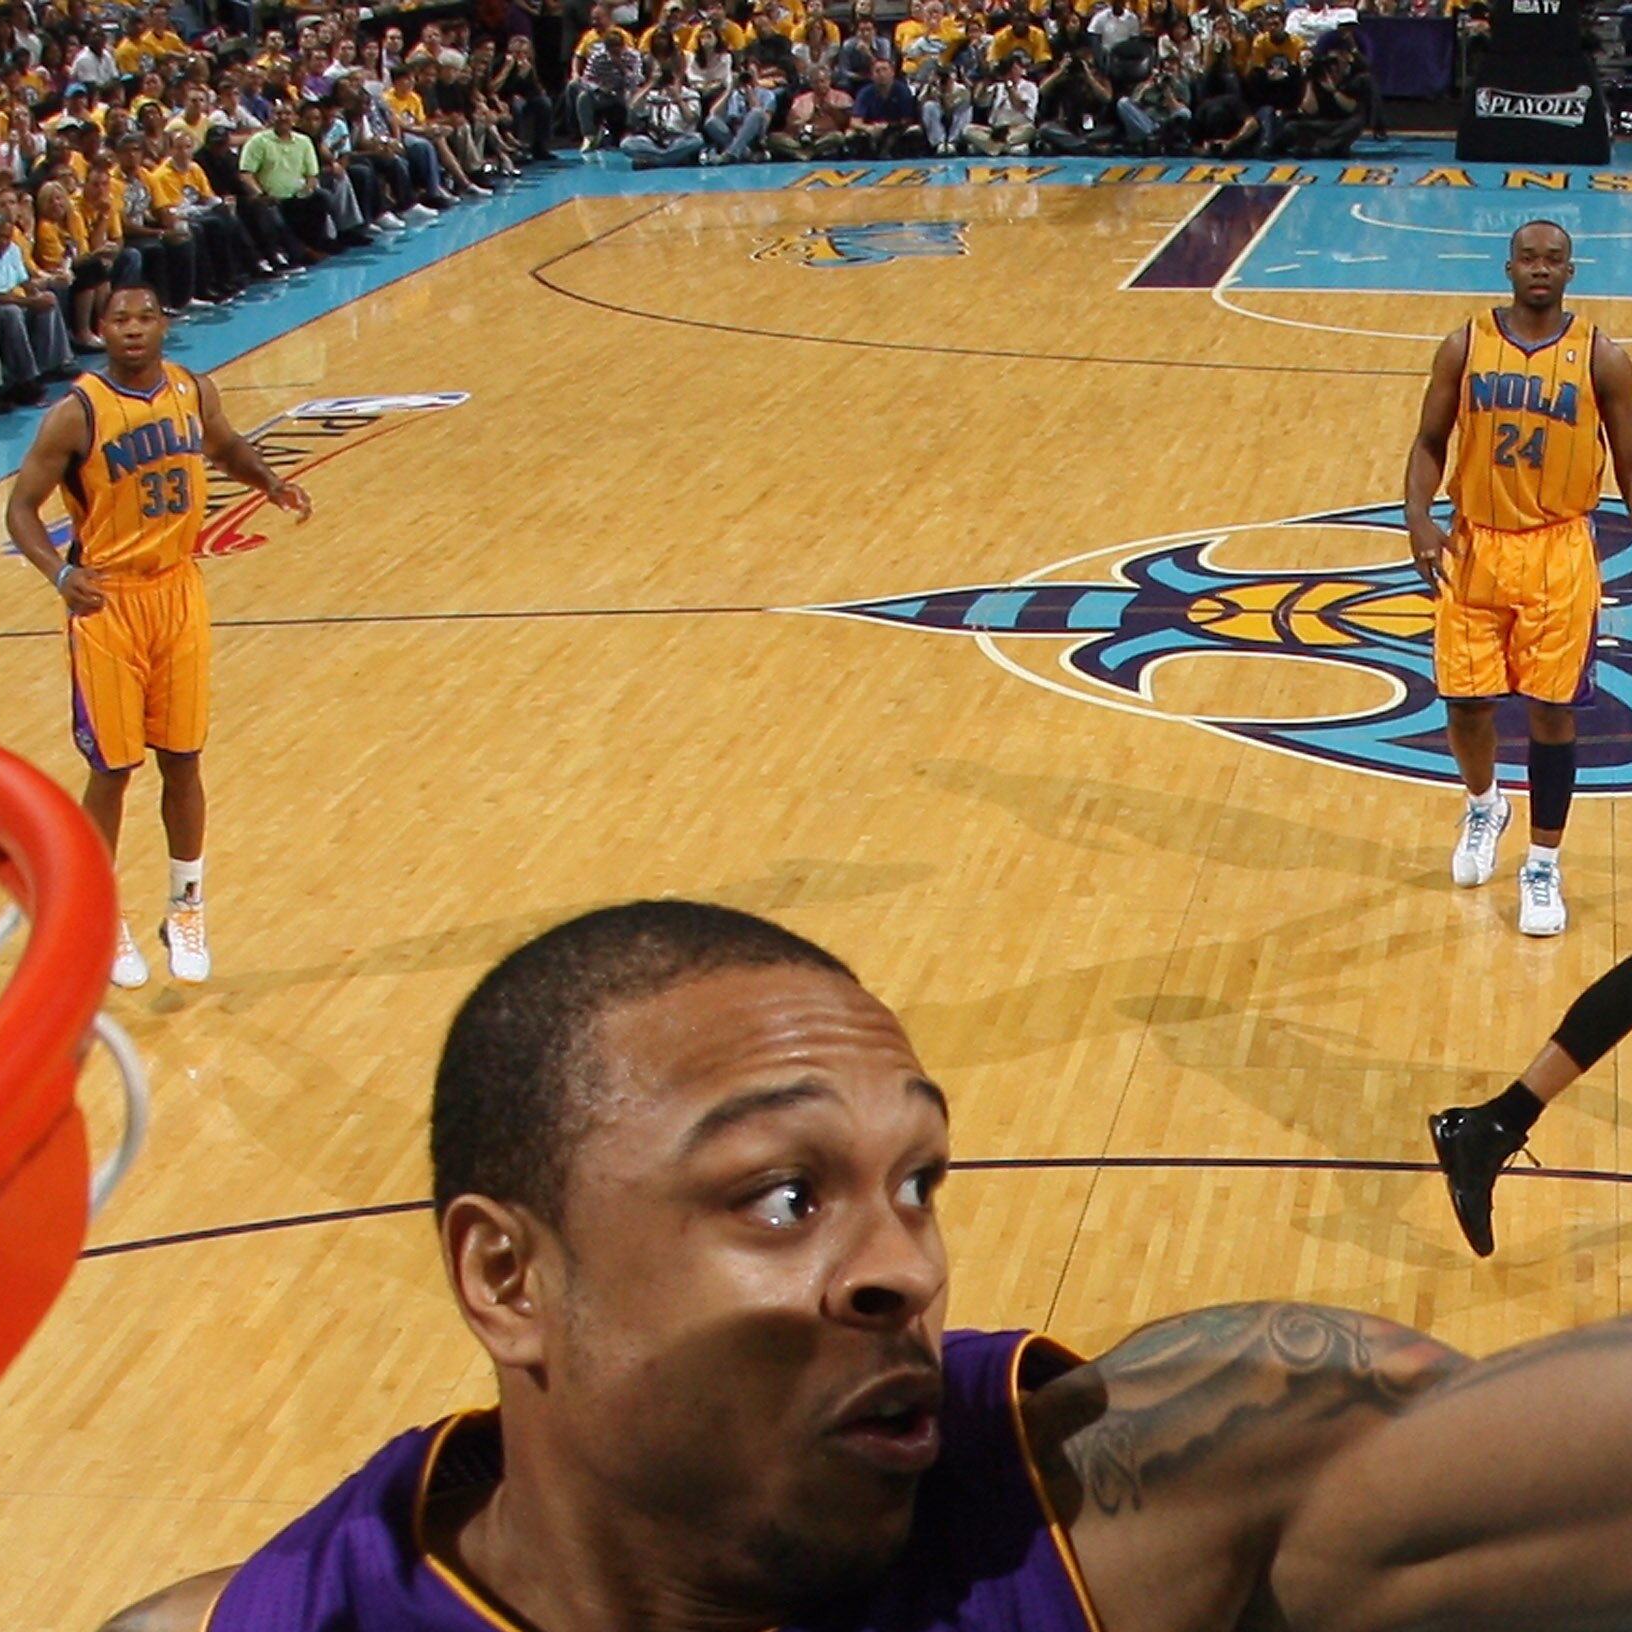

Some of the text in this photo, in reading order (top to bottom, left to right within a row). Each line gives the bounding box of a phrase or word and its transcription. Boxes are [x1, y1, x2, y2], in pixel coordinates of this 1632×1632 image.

[1489, 97, 1585, 115] PLAYOFFS
[784, 165, 1065, 189] NEW
[1470, 371, 1578, 425] NOLA
[102, 412, 204, 482] NOLA
[1494, 423, 1544, 468] 24
[140, 467, 190, 517] 33
